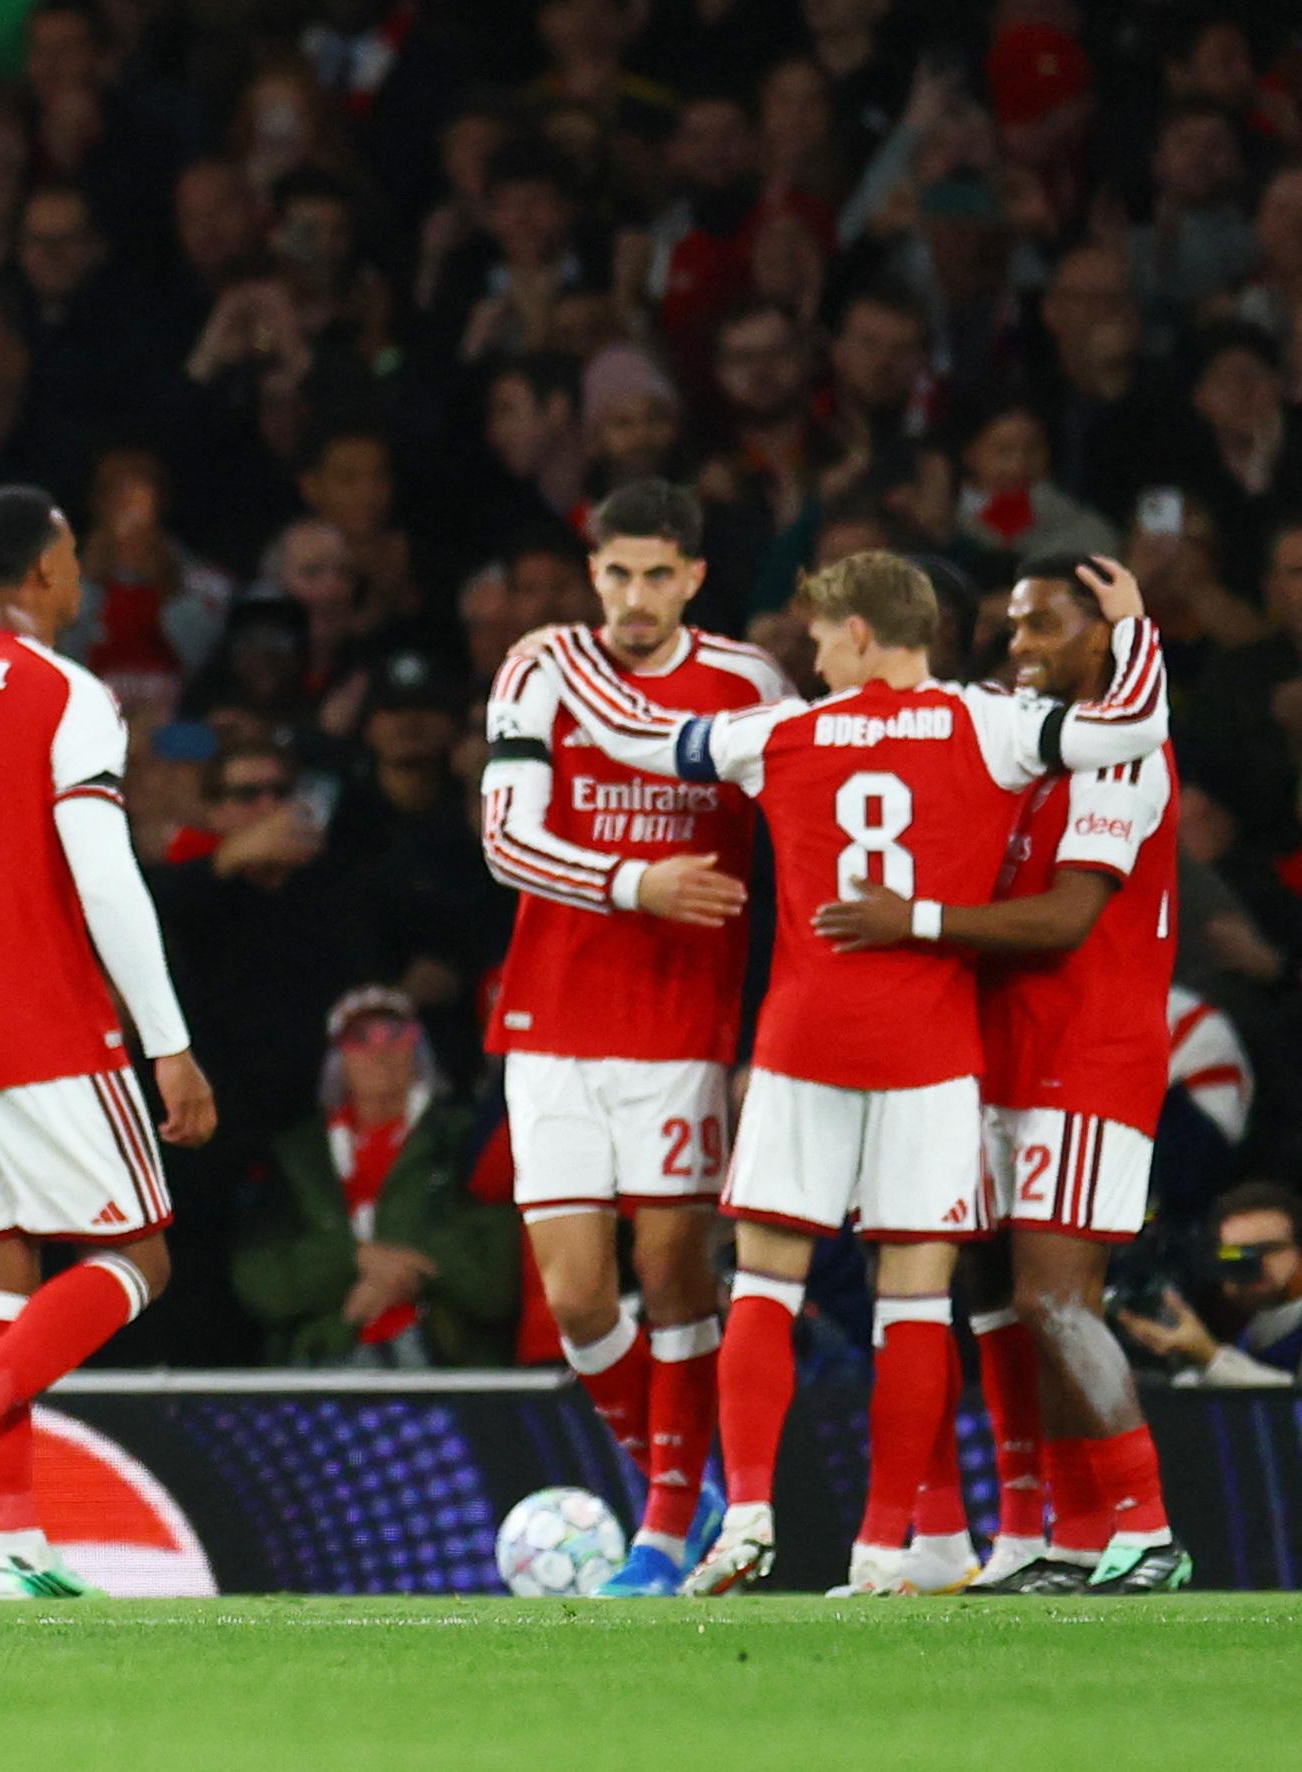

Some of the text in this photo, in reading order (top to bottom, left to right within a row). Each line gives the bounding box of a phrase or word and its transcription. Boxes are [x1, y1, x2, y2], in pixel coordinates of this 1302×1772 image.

[571, 774, 719, 812] Emirates
[835, 771, 914, 902] 8
[662, 1115, 723, 1178] 29
